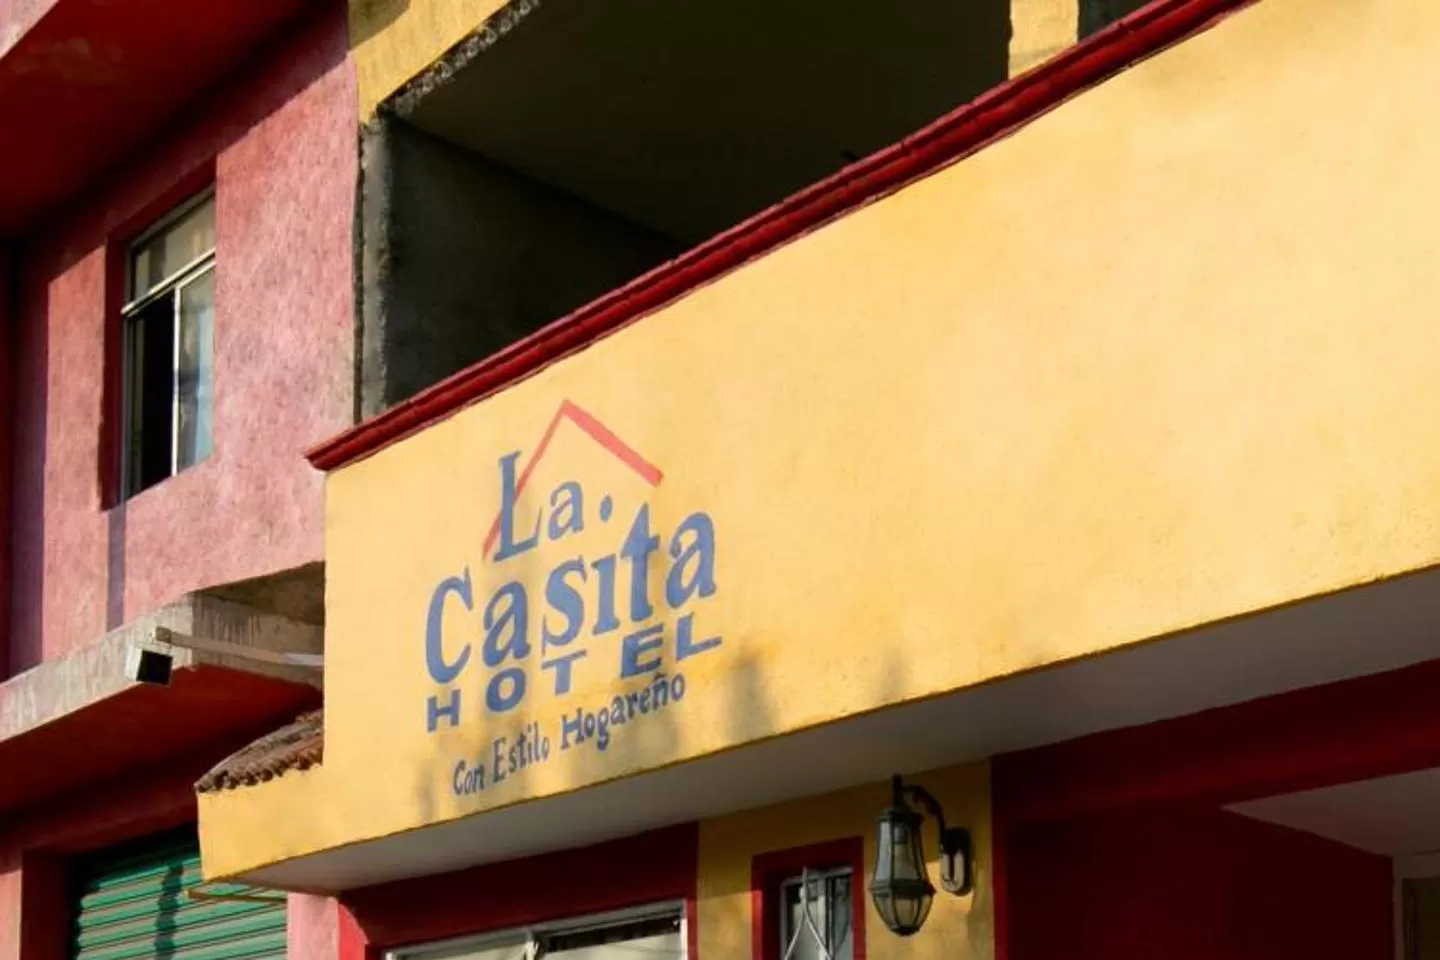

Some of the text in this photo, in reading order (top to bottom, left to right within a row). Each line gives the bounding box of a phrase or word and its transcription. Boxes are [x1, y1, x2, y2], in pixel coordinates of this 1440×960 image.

[493, 449, 585, 562] La
[425, 493, 718, 685] Casita
[427, 611, 722, 732] HOTEL
[453, 671, 686, 796] Con Estilo Hogareño
